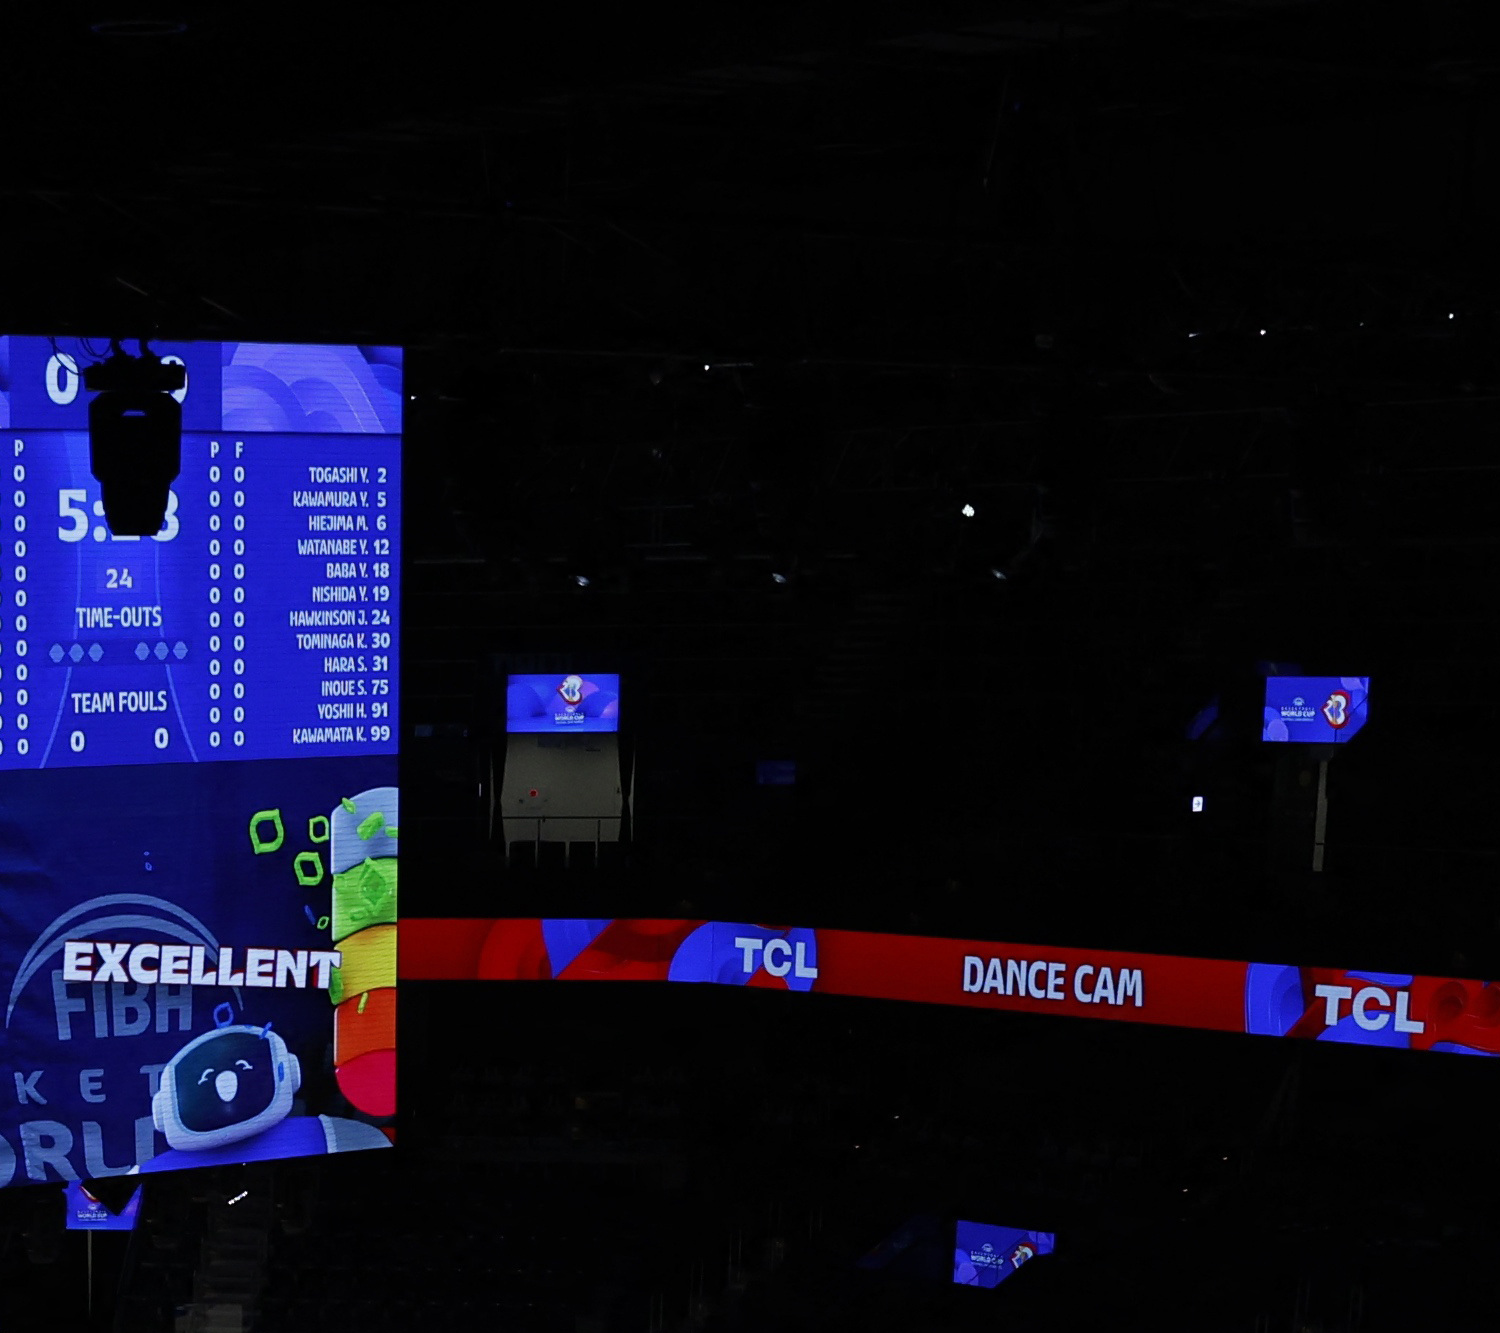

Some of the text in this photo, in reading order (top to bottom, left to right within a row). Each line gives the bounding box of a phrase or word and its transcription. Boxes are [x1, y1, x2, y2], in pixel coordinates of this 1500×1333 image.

[58, 490, 180, 543] 5:8
[107, 569, 132, 588] 24
[76, 606, 161, 628] TIME-OUTS
[71, 691, 167, 713] TEAM FOULS
[63, 940, 341, 989] EXCELLENT
[735, 937, 817, 978] TCL
[964, 956, 1142, 1006] DANCE CAM
[1315, 985, 1424, 1033] TCL
